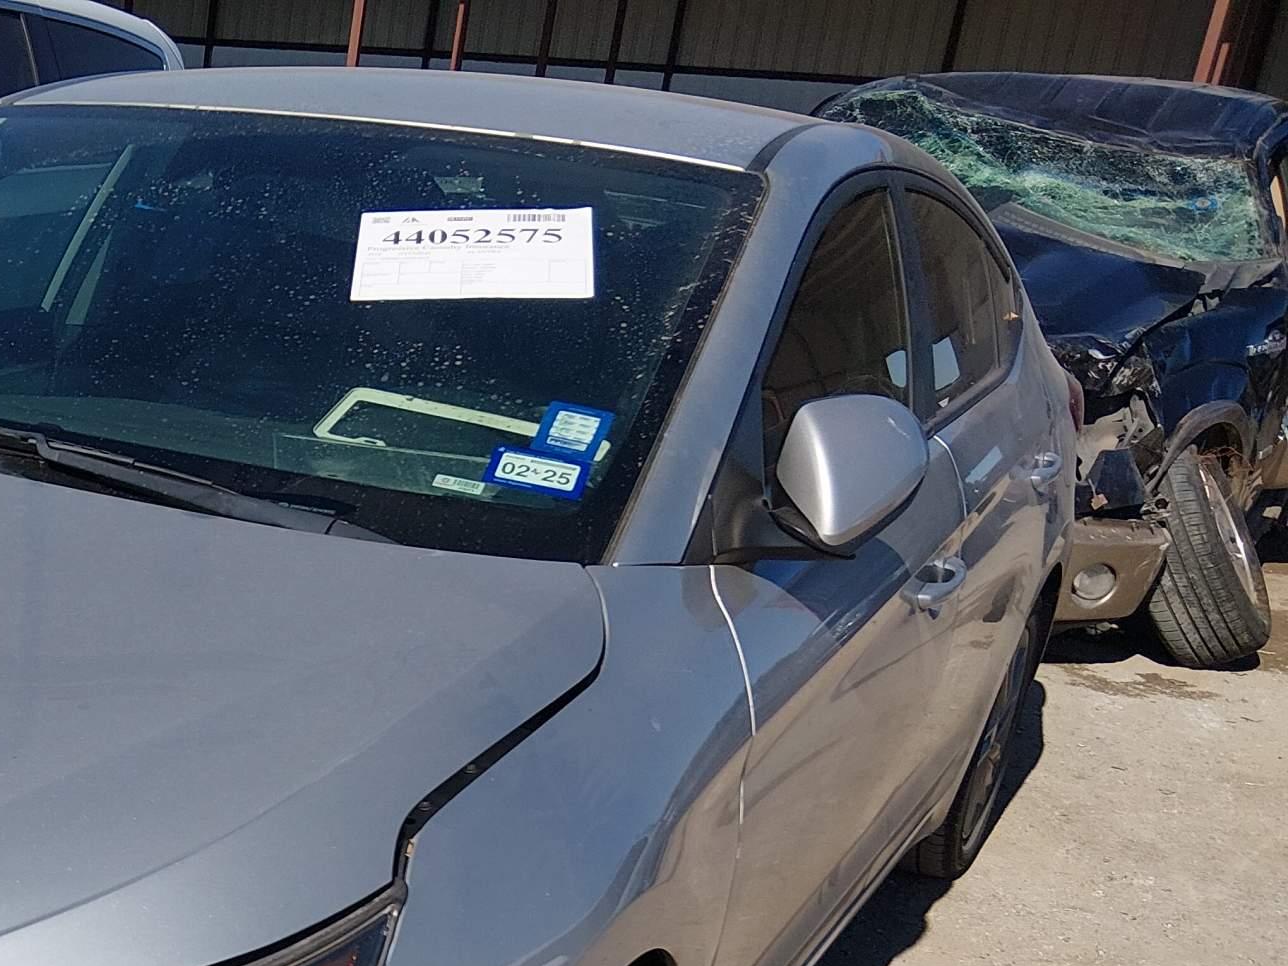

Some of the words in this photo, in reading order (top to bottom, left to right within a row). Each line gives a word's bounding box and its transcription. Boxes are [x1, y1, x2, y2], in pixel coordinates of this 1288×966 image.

[382, 228, 563, 245] 44052575
[501, 461, 531, 478] 02
[541, 468, 572, 486] 25
